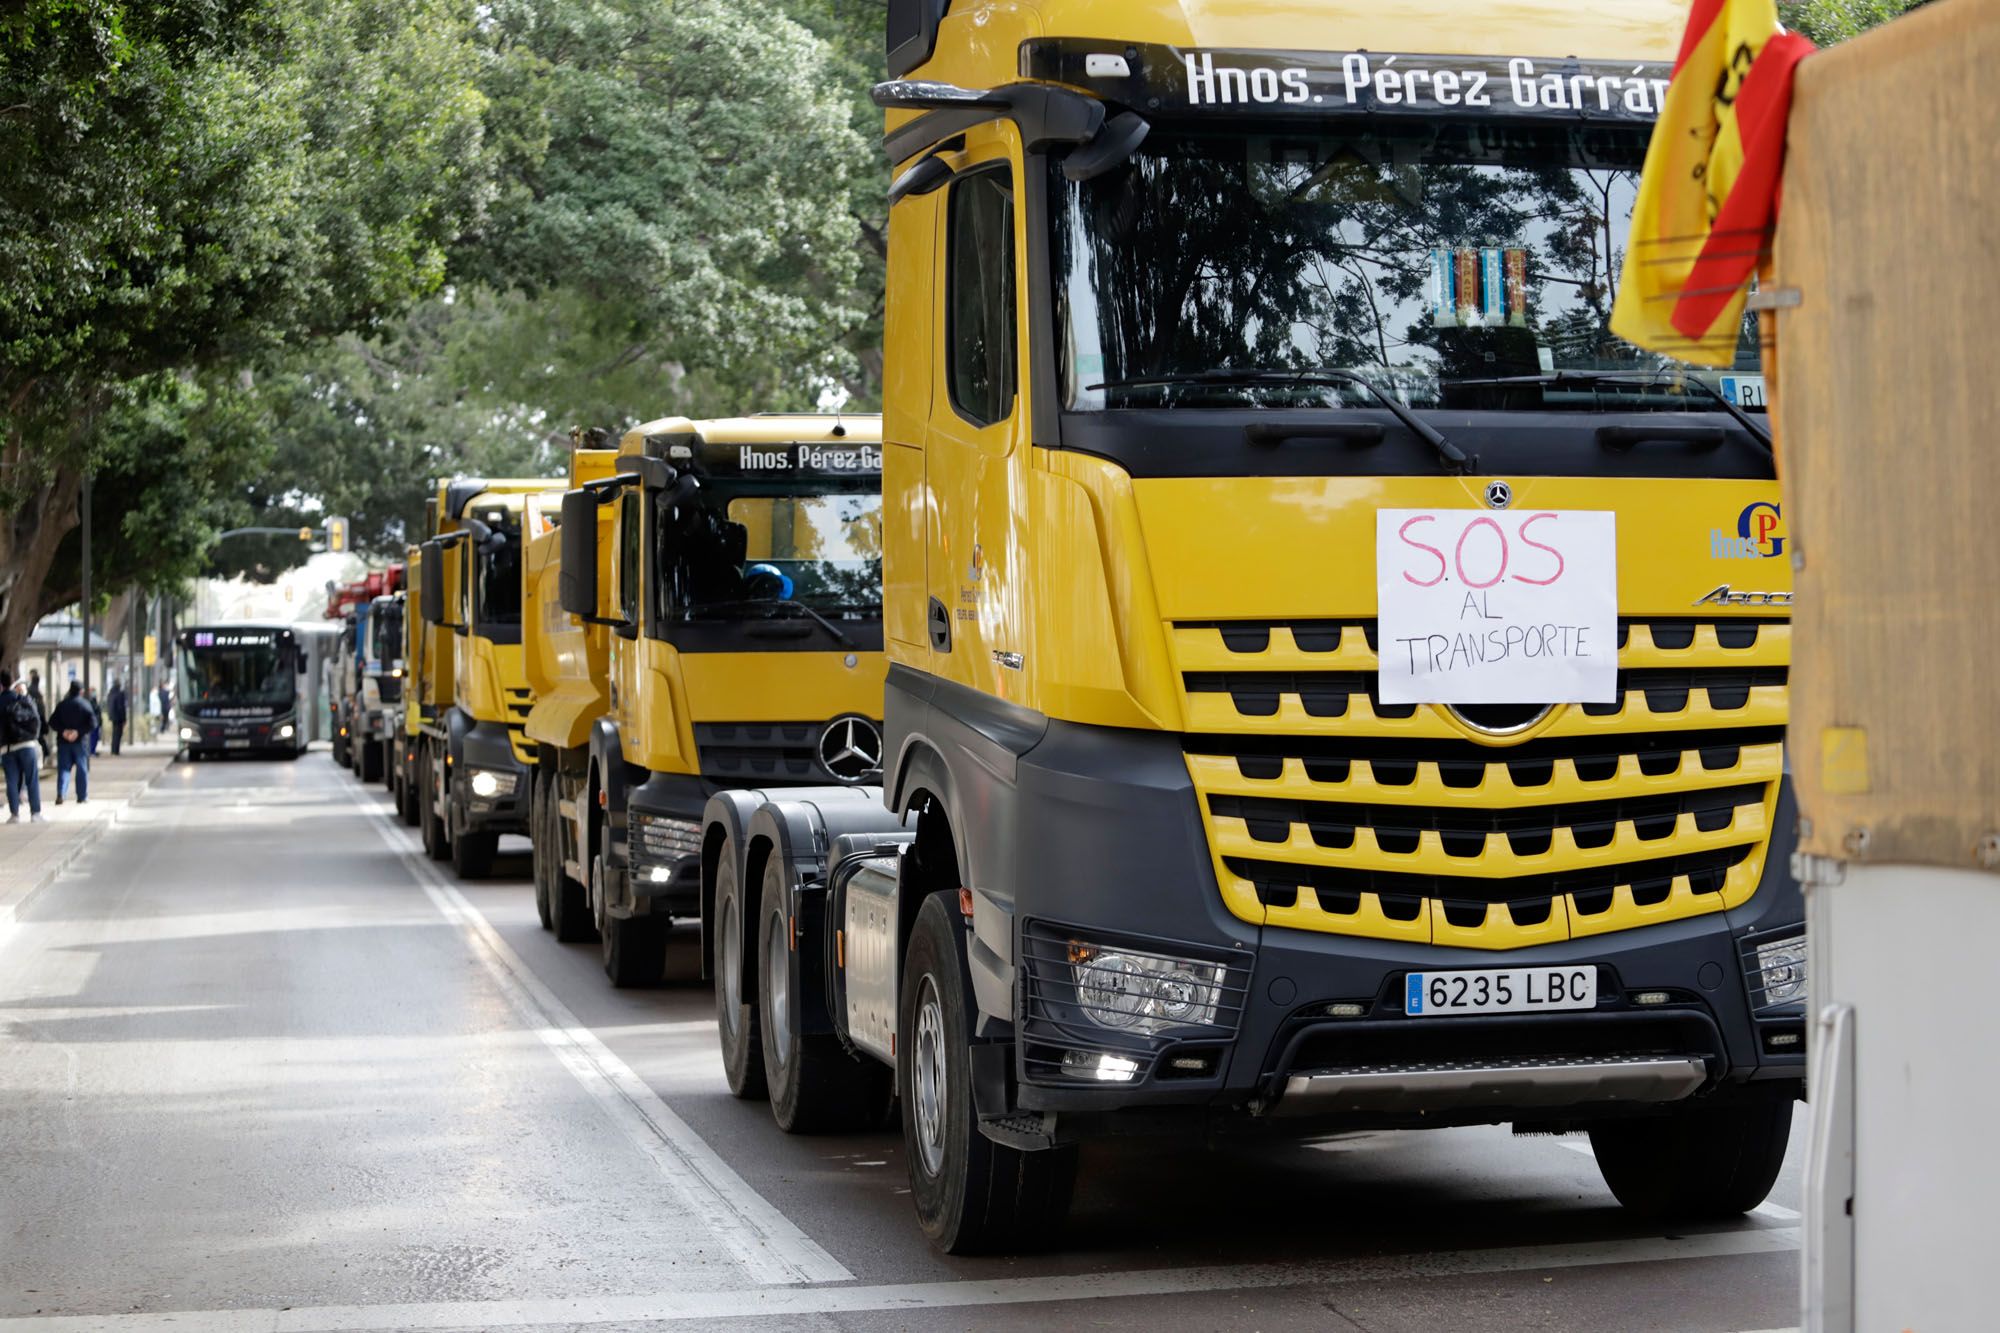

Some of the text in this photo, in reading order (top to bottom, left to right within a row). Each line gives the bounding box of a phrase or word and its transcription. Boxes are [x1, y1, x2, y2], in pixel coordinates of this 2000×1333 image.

[1185, 53, 1323, 104] Hnos.
[1342, 53, 1491, 106] Pérez
[740, 446, 793, 470] Hnos.
[798, 445, 857, 469] Pérez
[1710, 528, 1764, 559] Hnos.
[1460, 590, 1503, 620] AL
[1396, 624, 1591, 675] TRANSPORTE
[1430, 971, 1586, 1008] 6235 LBC
